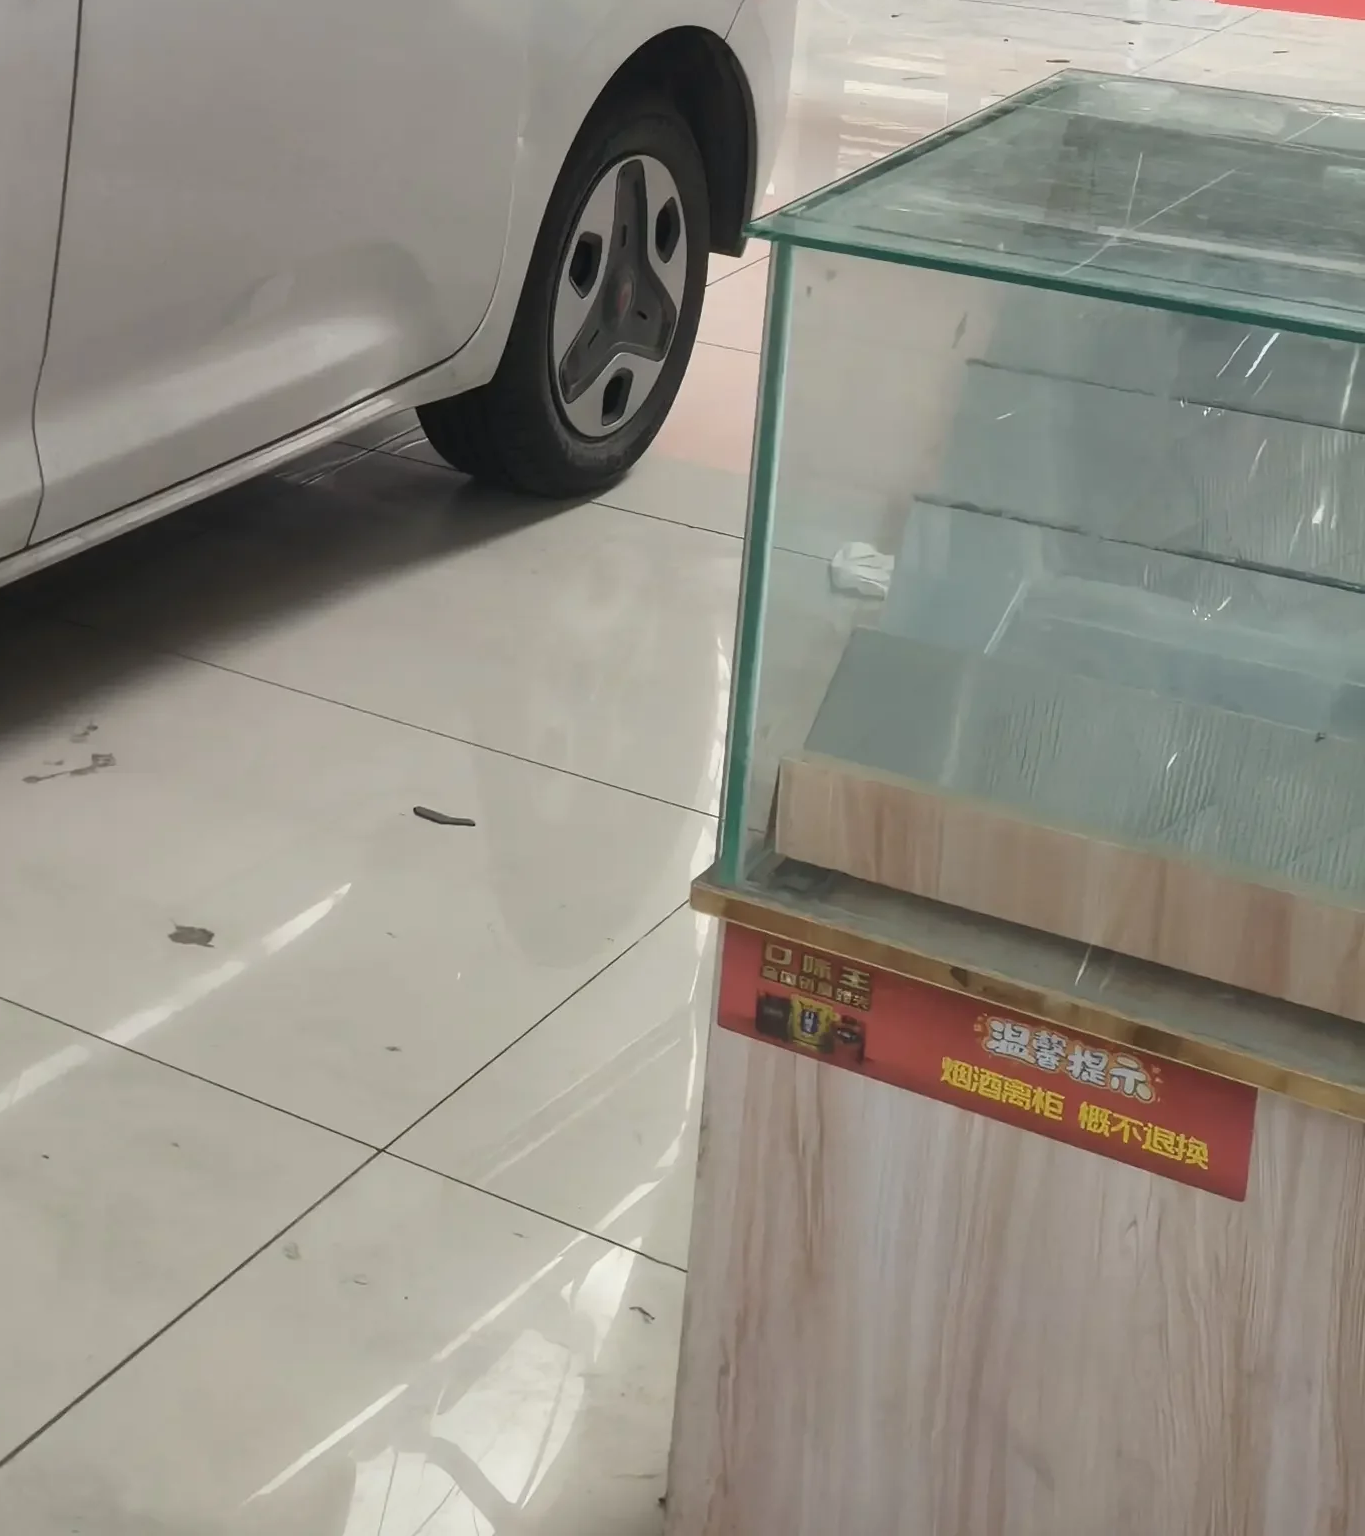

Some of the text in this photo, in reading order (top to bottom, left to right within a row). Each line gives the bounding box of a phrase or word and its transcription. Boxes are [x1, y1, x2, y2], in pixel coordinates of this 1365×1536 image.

[986, 1020, 1153, 1103] 温馨提示
[941, 1055, 1210, 1171] 烟酒离柜 概不退换
